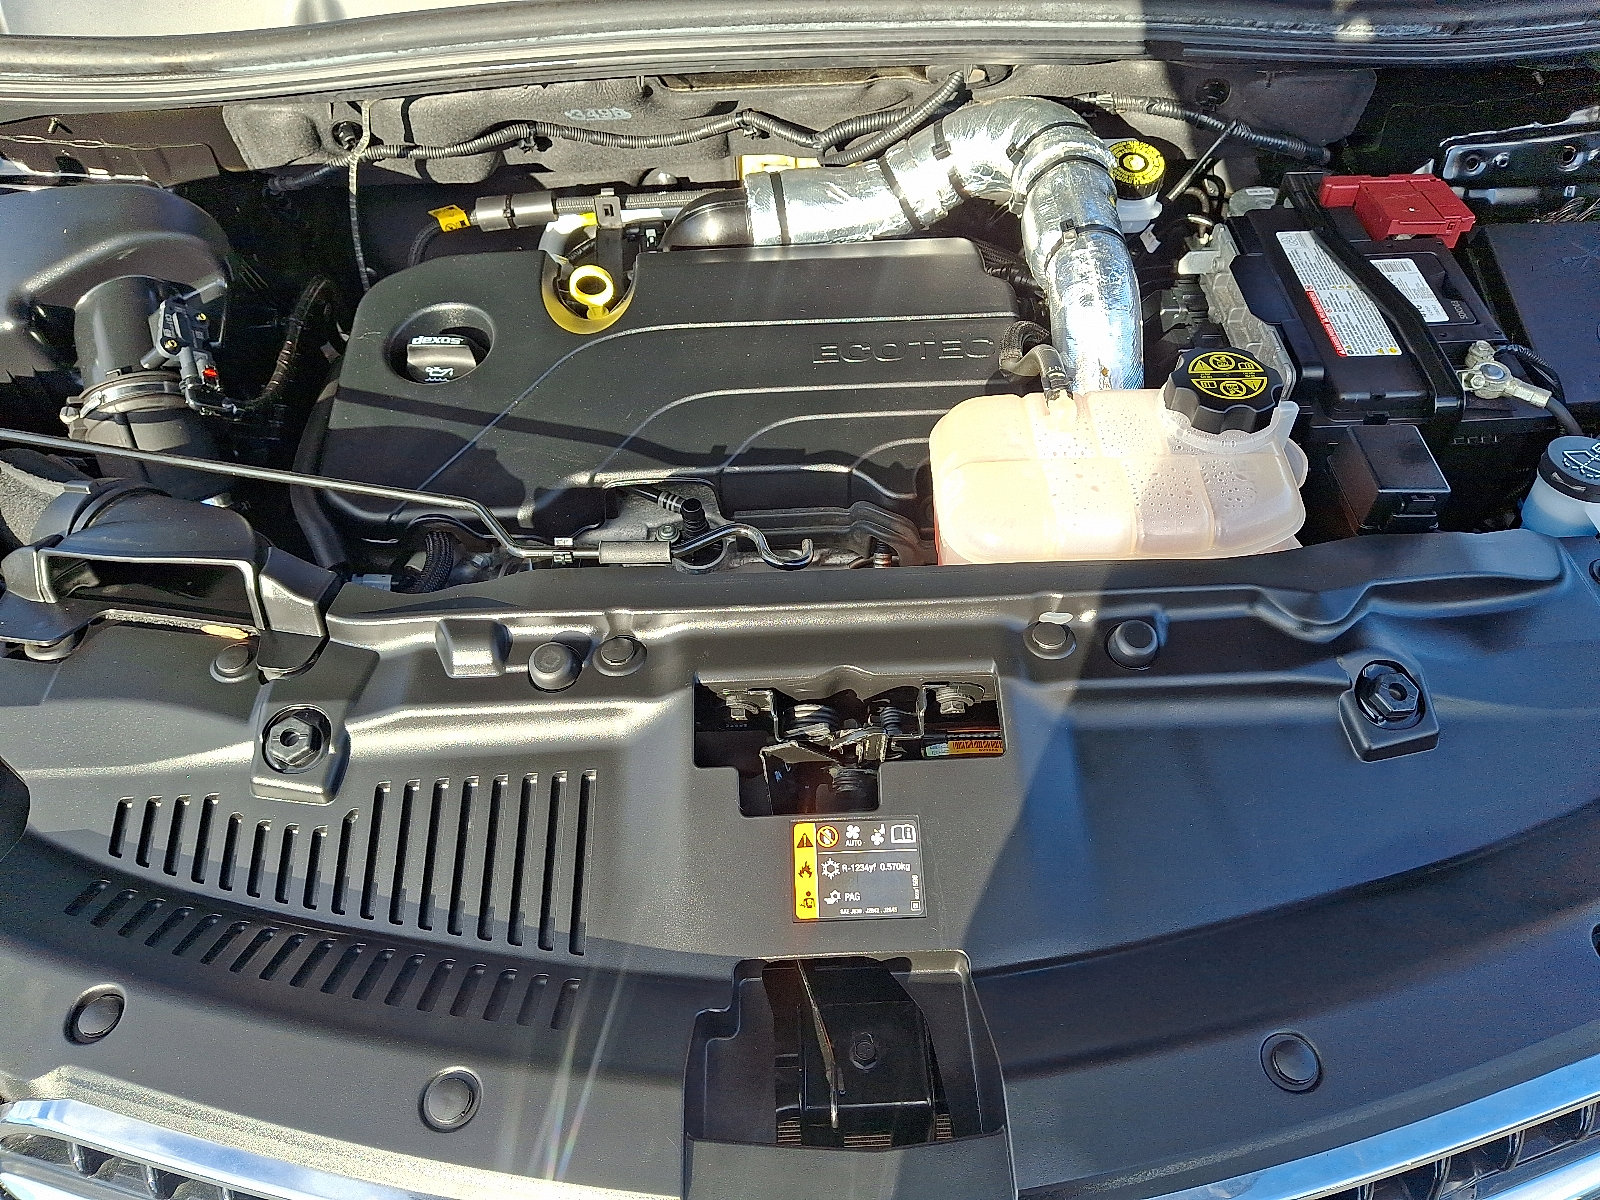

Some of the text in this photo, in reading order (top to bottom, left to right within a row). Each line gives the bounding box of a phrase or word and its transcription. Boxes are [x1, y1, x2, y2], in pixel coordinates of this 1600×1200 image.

[411, 335, 463, 345] dexos
[812, 337, 997, 364] ECOTEC
[845, 839, 863, 847] AUTO
[841, 862, 911, 873] R-1234yf 0.570kg
[844, 892, 861, 901] PAG
